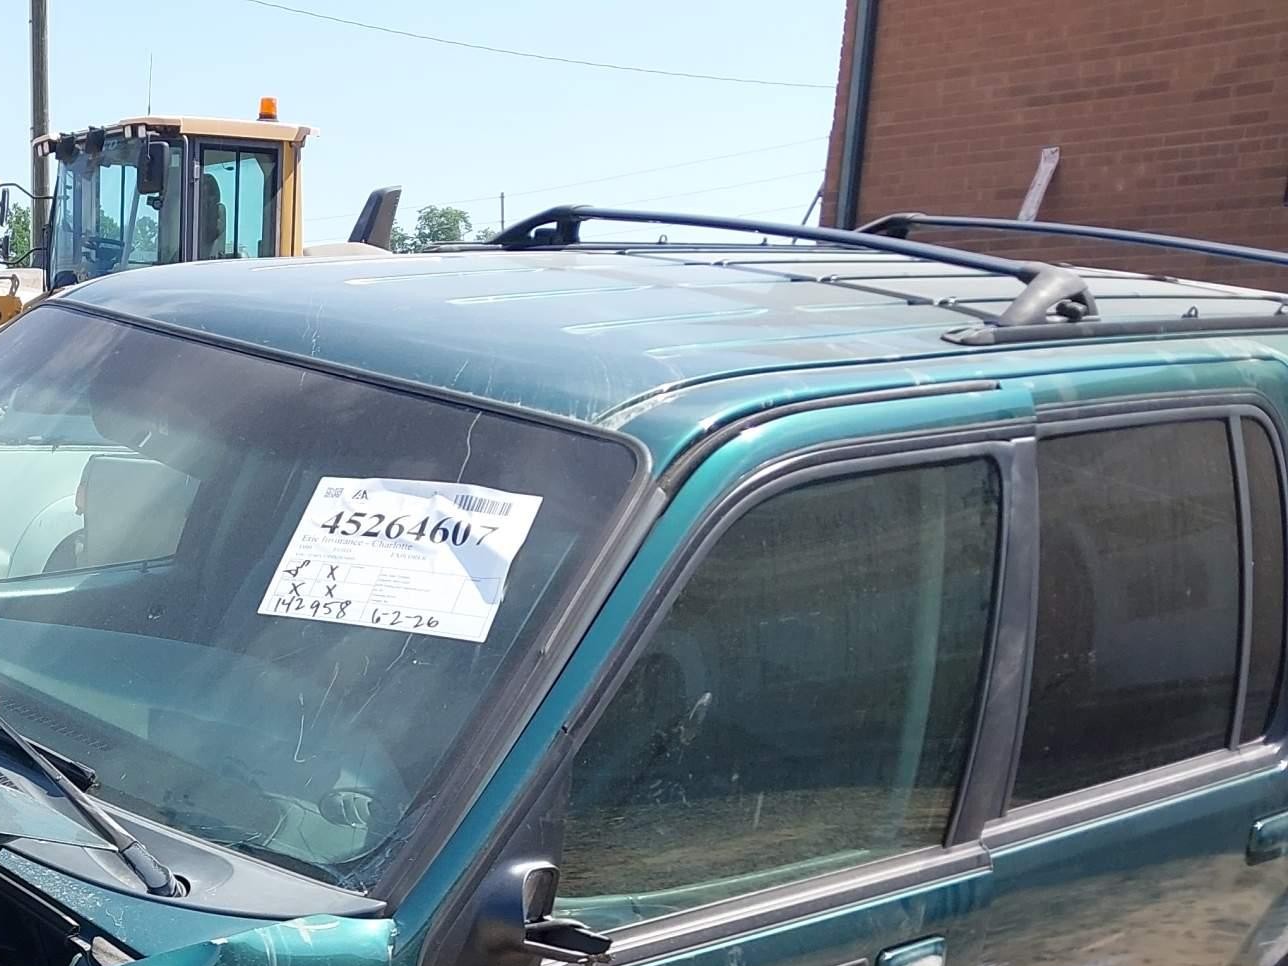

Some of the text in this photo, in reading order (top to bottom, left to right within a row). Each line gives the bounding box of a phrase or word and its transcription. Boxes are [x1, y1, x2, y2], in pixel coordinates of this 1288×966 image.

[321, 510, 500, 547] 45264607
[371, 539, 413, 551] Charlotte
[371, 608, 439, 629] 6-2-26
